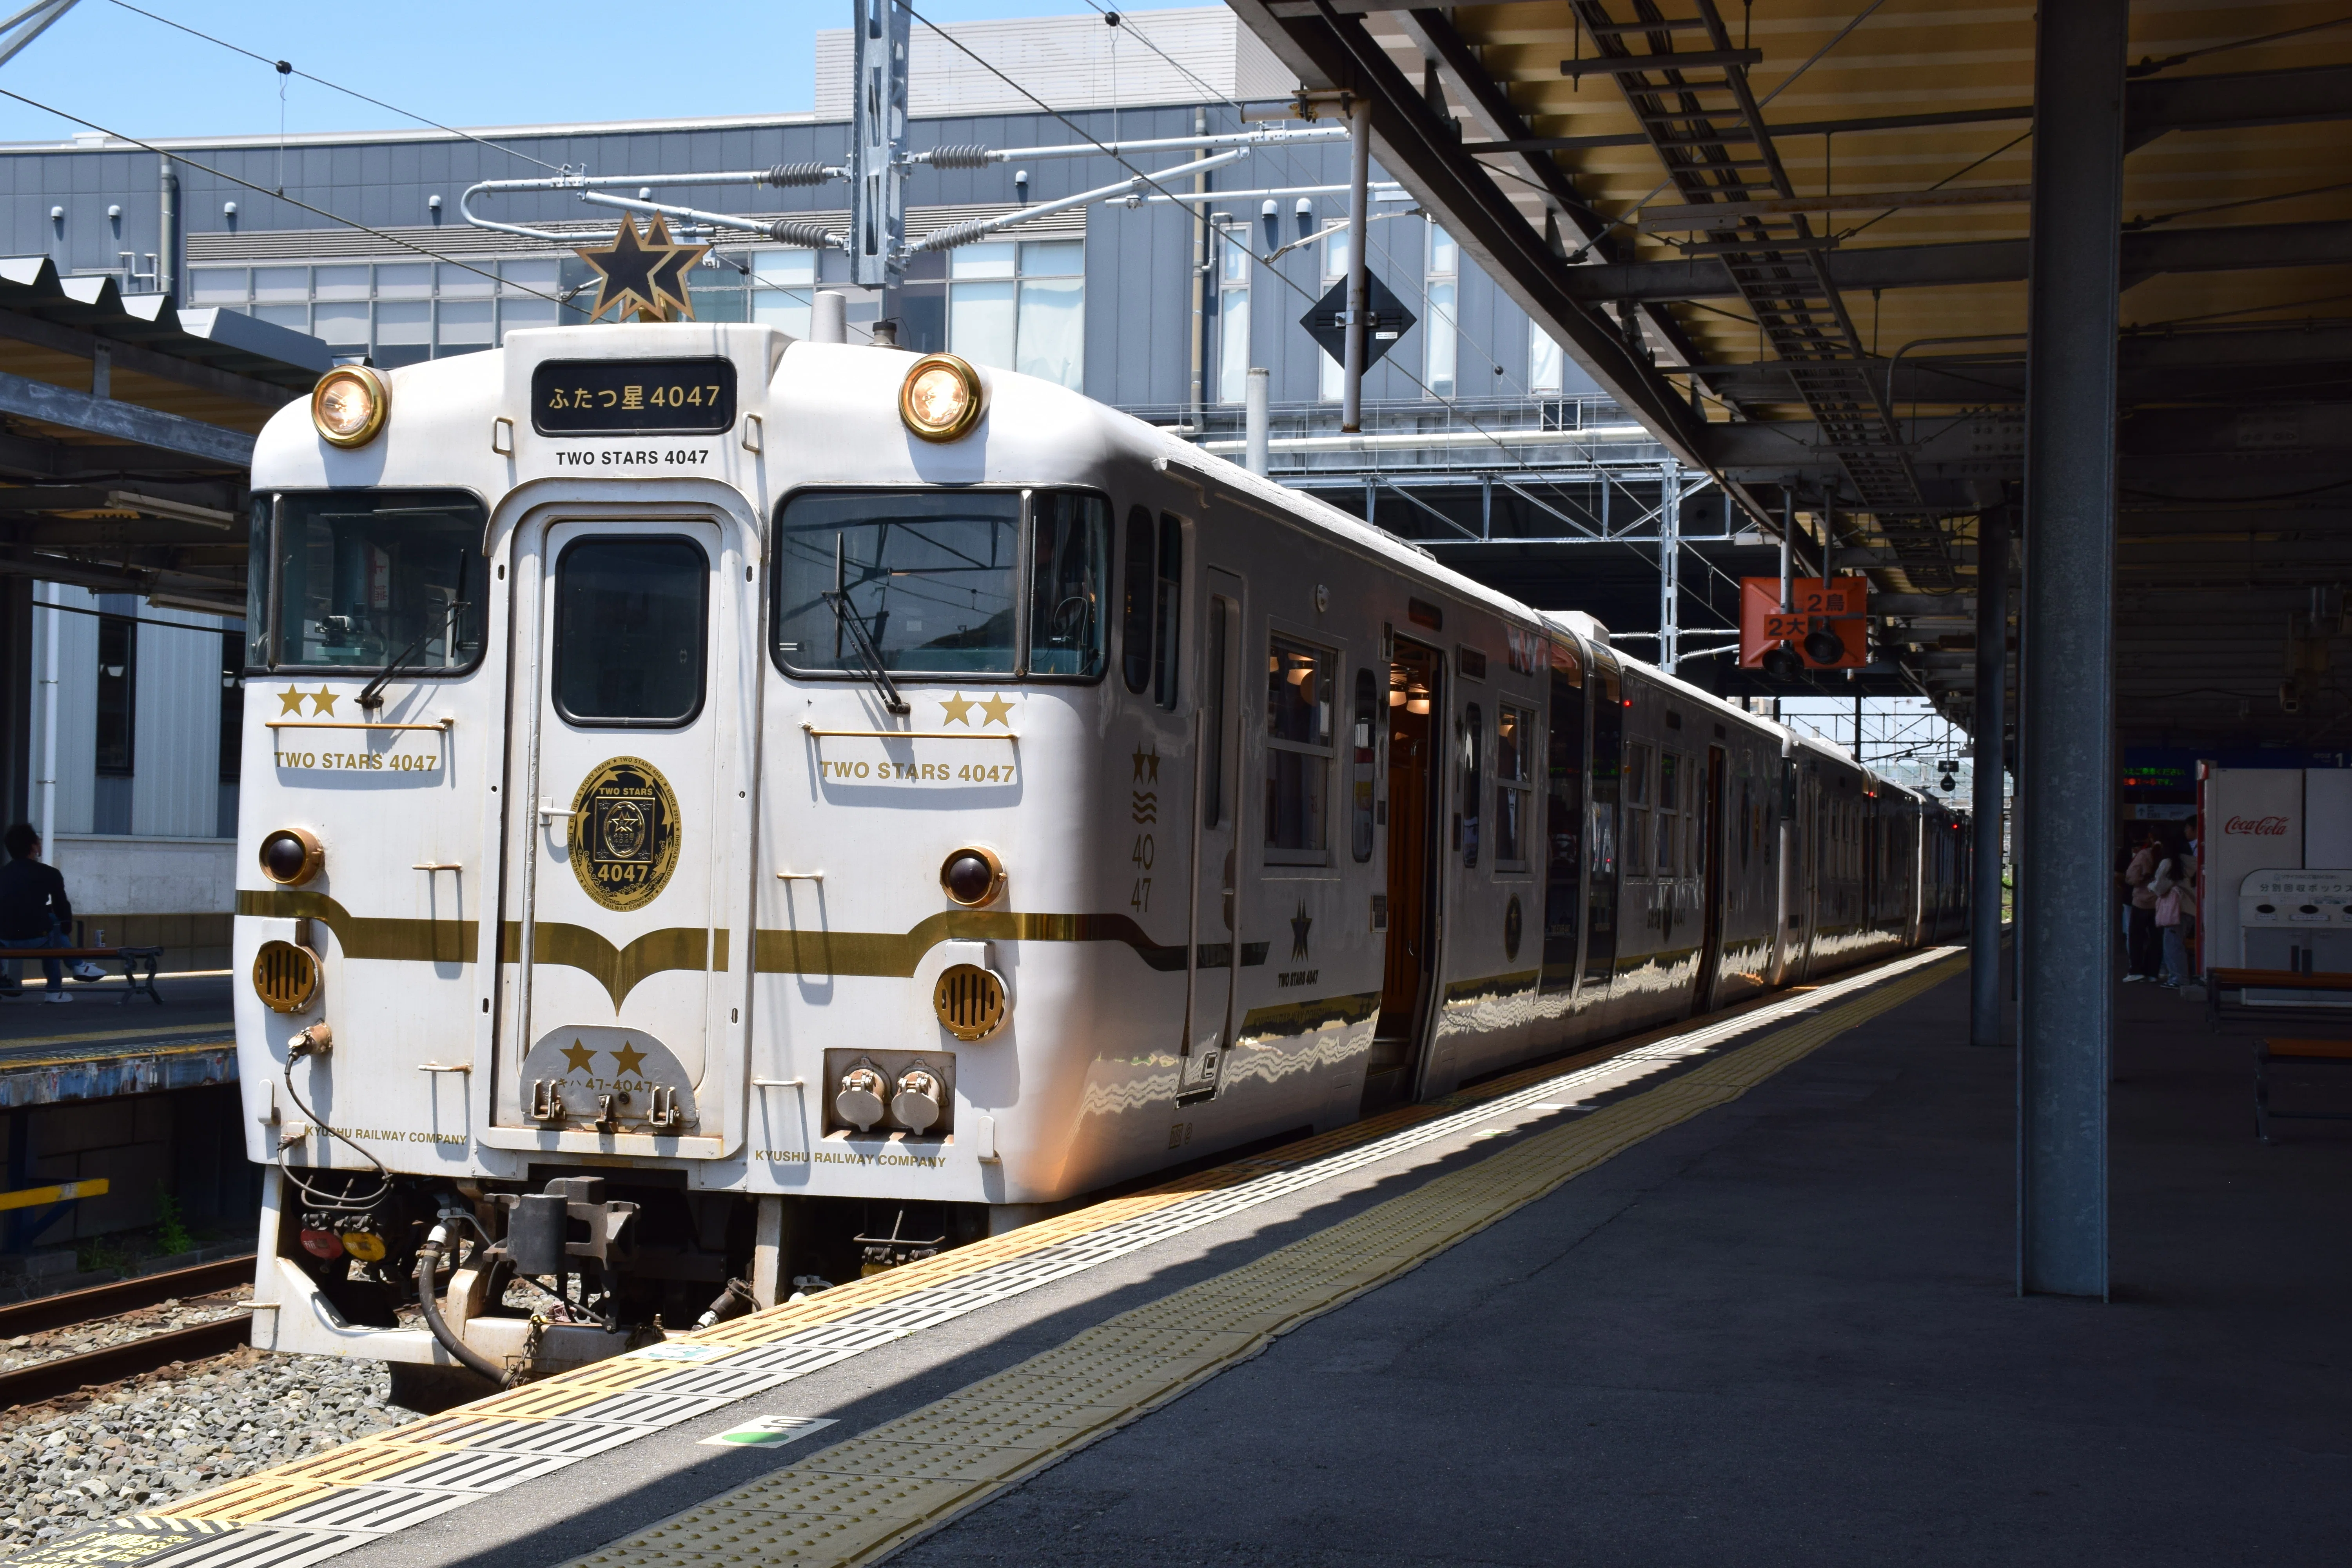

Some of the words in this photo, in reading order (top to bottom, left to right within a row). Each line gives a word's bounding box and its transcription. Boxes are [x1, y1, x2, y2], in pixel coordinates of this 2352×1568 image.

[549, 385, 720, 410] ふたつ星4047
[556, 452, 595, 466] TWO
[601, 450, 658, 465] STARS
[664, 450, 709, 465] 4047
[1808, 593, 1845, 612] 2鳥
[1768, 618, 1806, 637] 2大
[274, 751, 316, 769] TWO
[322, 753, 383, 770] STARS
[389, 754, 437, 771] 4047
[634, 759, 652, 770] STARS
[652, 769, 664, 781] 4047
[2335, 752, 2344, 768] 1
[819, 761, 870, 779] TWO
[877, 762, 950, 781] STARS
[958, 764, 1015, 782] 4047
[570, 799, 580, 822] DIGN
[580, 773, 595, 791] STORY
[594, 761, 611, 773] TRAIN
[622, 788, 653, 796] STARS
[666, 788, 677, 808] SINCE
[2225, 816, 2291, 836] Coca-Cola
[568, 833, 581, 878] FUTATSUBOSHI
[1132, 833, 1154, 871] 40
[598, 864, 648, 882] 4047
[660, 861, 676, 889] DISCOVER
[583, 884, 602, 903] KYUSHU
[602, 902, 627, 911] RAILWAY
[629, 893, 655, 910] COMPANY
[1131, 877, 1152, 913] 47
[2260, 884, 2352, 892] 分別回収ボックス
[1278, 973, 1289, 988] TWO
[1290, 971, 1305, 987] STARS
[1306, 969, 1319, 985] 4047
[557, 1078, 581, 1088] キハ
[585, 1078, 653, 1094] 47-4047
[355, 1128, 407, 1142] RAILWAY
[409, 1132, 467, 1145] COMPANY
[755, 1150, 810, 1162] KYUSHU
[814, 1151, 875, 1165] RAILWAY
[878, 1154, 947, 1168] COMPANY
[760, 1419, 816, 1429] 10
[107, 1535, 193, 1563] 발밑조심
